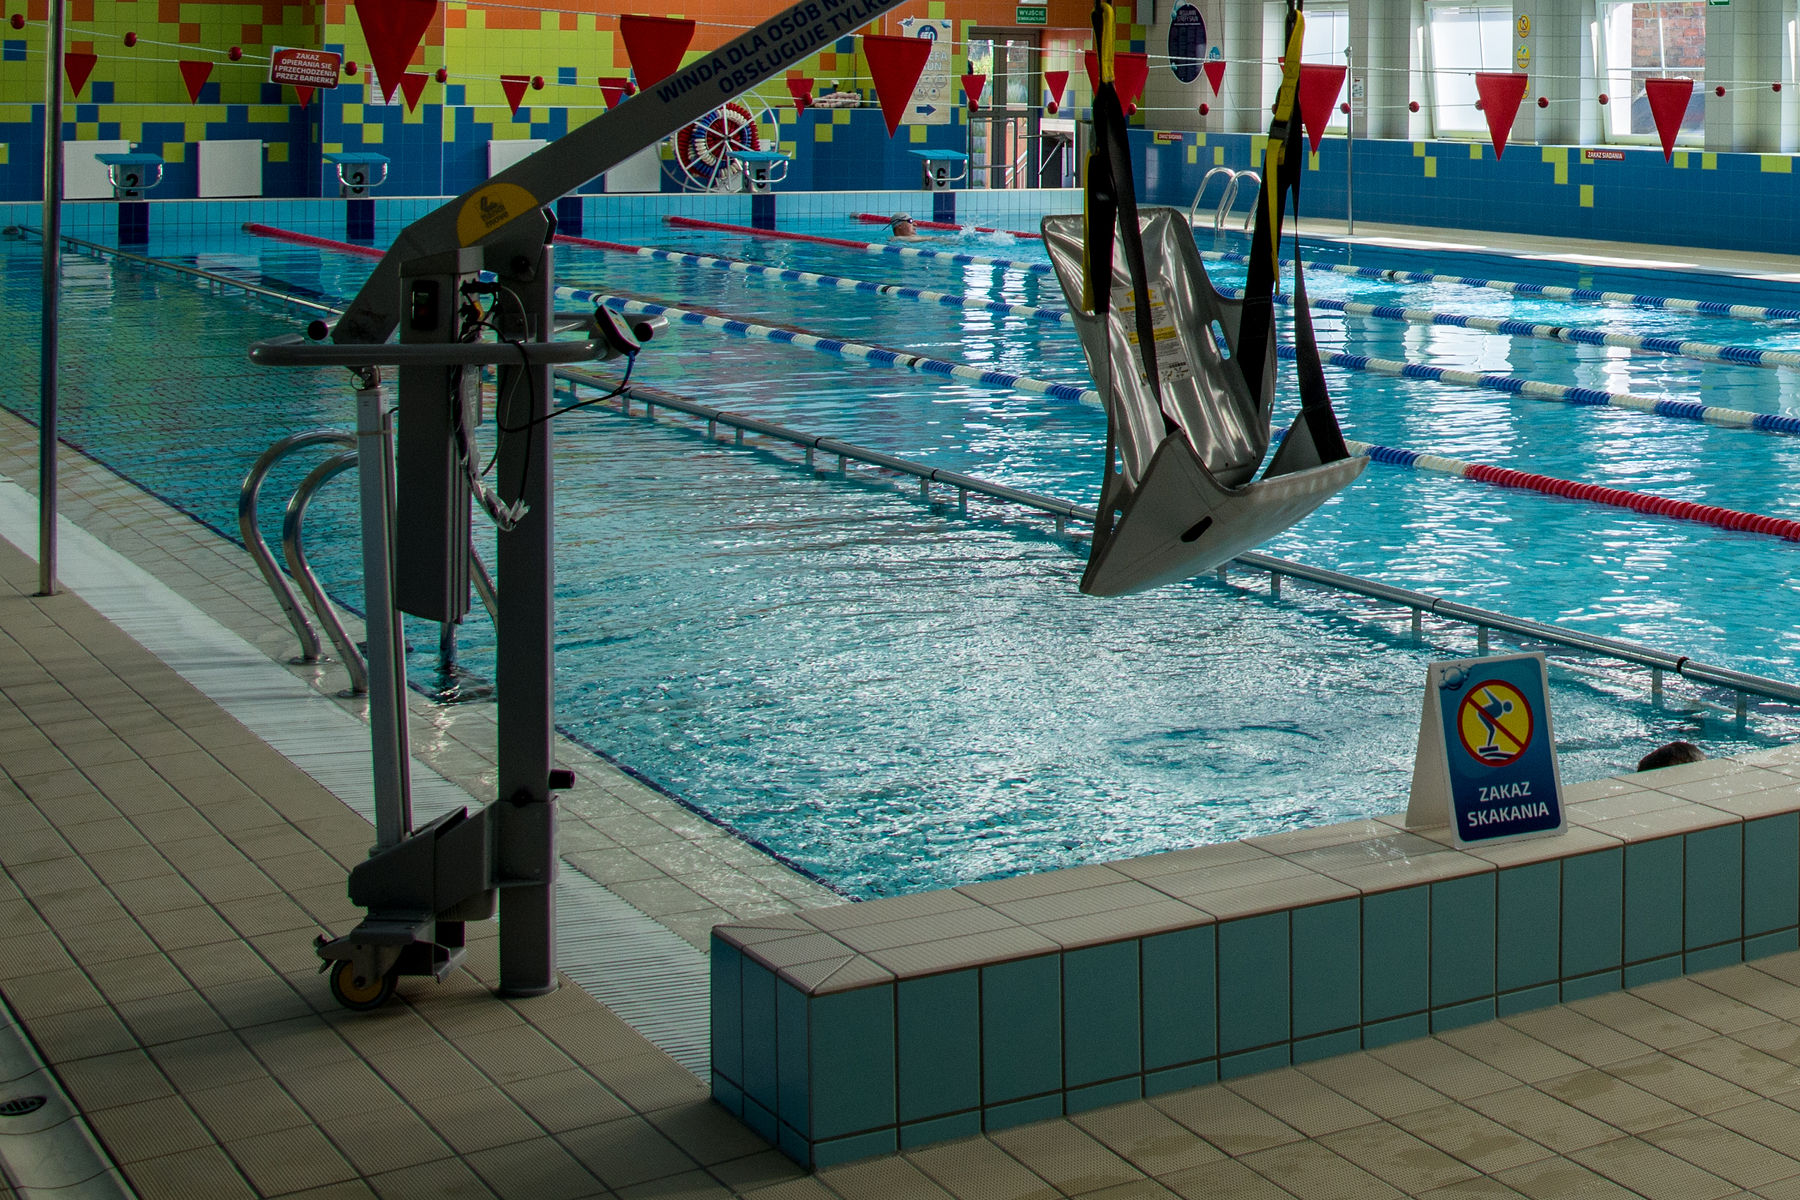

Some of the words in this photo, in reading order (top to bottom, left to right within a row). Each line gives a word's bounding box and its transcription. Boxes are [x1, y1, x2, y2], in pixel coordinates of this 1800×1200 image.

[281, 58, 320, 68] OPIERANIA
[296, 52, 320, 60] ZAKAZ
[656, 58, 723, 104] WINDA
[726, 36, 767, 63] DLA
[767, 3, 822, 42] OSÓB
[718, 23, 828, 94] OBSŁUGUJE
[276, 72, 299, 80] PRZEZ
[278, 65, 337, 78] PRZECHODZENIA
[125, 173, 138, 197] 2
[352, 172, 364, 194] 3
[756, 169, 766, 189] 5
[937, 167, 946, 187] 6
[1479, 781, 1531, 803] ZAKAZ
[1467, 801, 1549, 828] SKAKANIA
